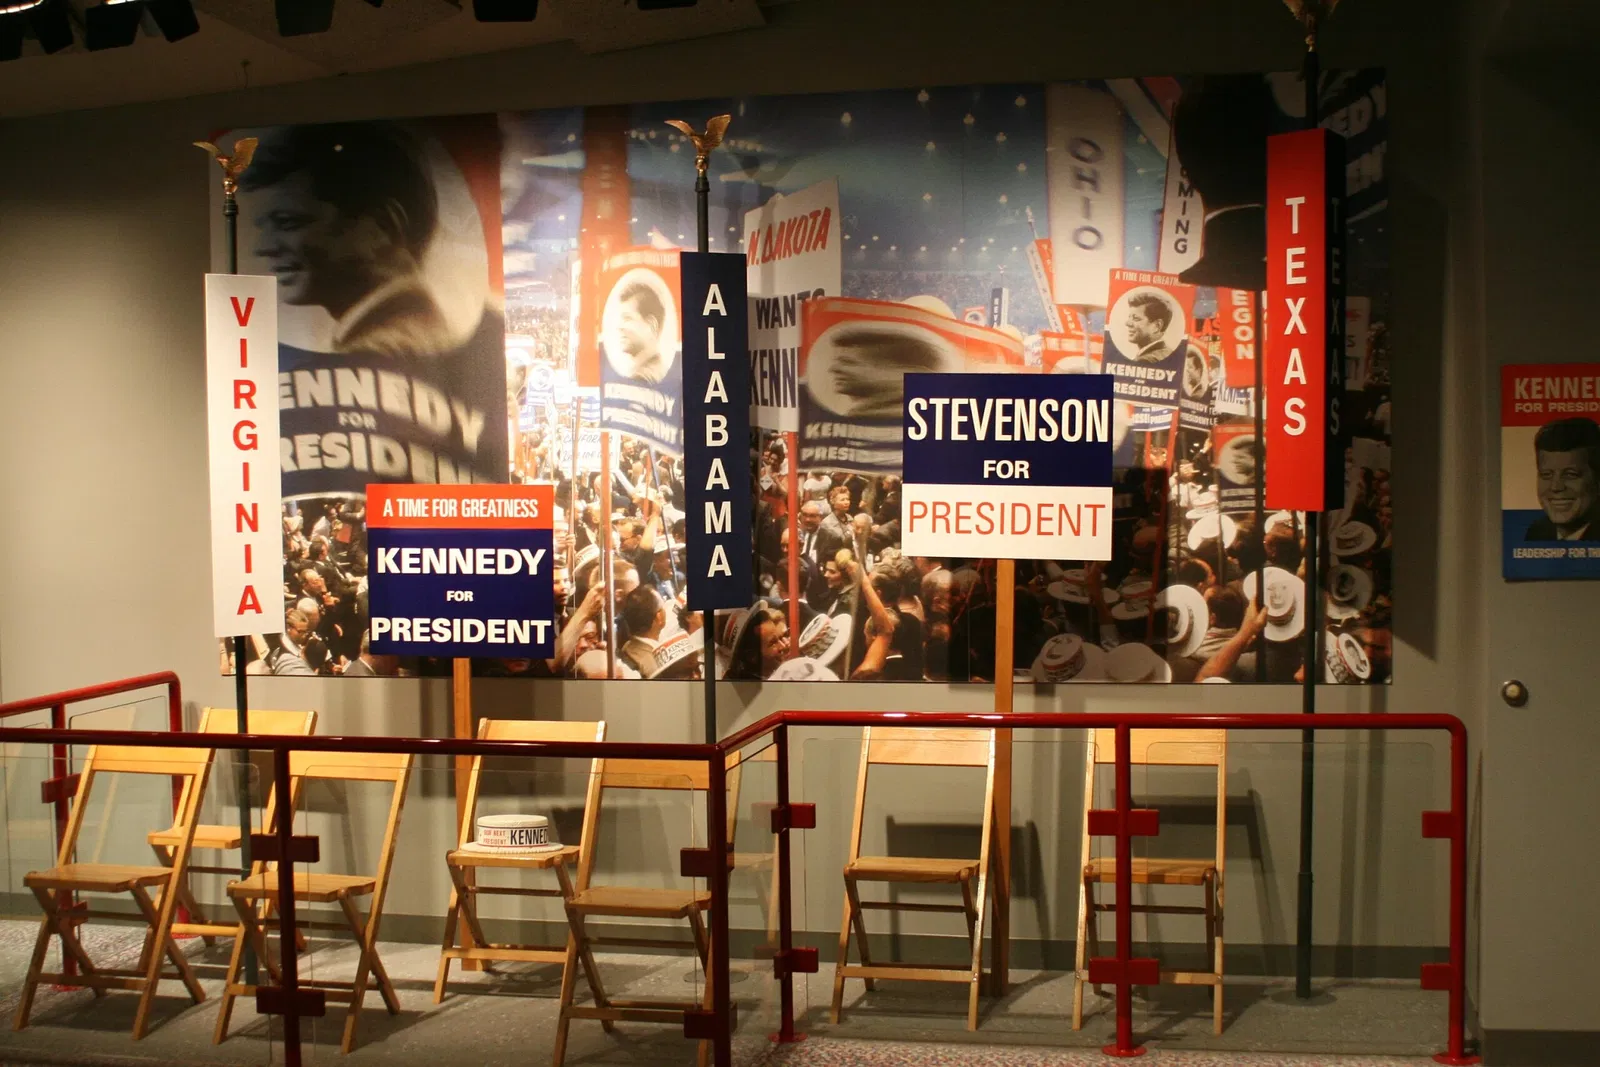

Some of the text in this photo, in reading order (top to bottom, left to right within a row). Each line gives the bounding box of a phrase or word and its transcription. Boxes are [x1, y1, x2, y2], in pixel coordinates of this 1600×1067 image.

[1069, 137, 1103, 250] OHIO
[761, 206, 832, 264] DAKOTA
[1114, 270, 1120, 280] A
[1231, 290, 1254, 360] EGON
[1283, 196, 1308, 436] TEXAS
[748, 347, 798, 408] KENN
[1105, 362, 1177, 382] KENNEDY
[1113, 382, 1177, 400] RESIDENT
[1514, 376, 1600, 399] KENNE
[278, 367, 485, 455] ENNEDY
[337, 411, 377, 430] FOR
[907, 397, 1109, 442] STEVENSON
[1514, 401, 1600, 413] FOR PRESID
[702, 283, 733, 578] ALABAMA
[229, 296, 263, 616] VIRGINIA
[983, 459, 1030, 479] FOR
[383, 498, 539, 518] A TIME FOR GREATNESS
[909, 501, 1106, 537] PRESIDENT
[377, 547, 547, 575] KENNEDY
[1513, 547, 1566, 559] LEADERSHIP
[446, 590, 474, 602] FOR
[371, 617, 552, 645] PRESIDENT
